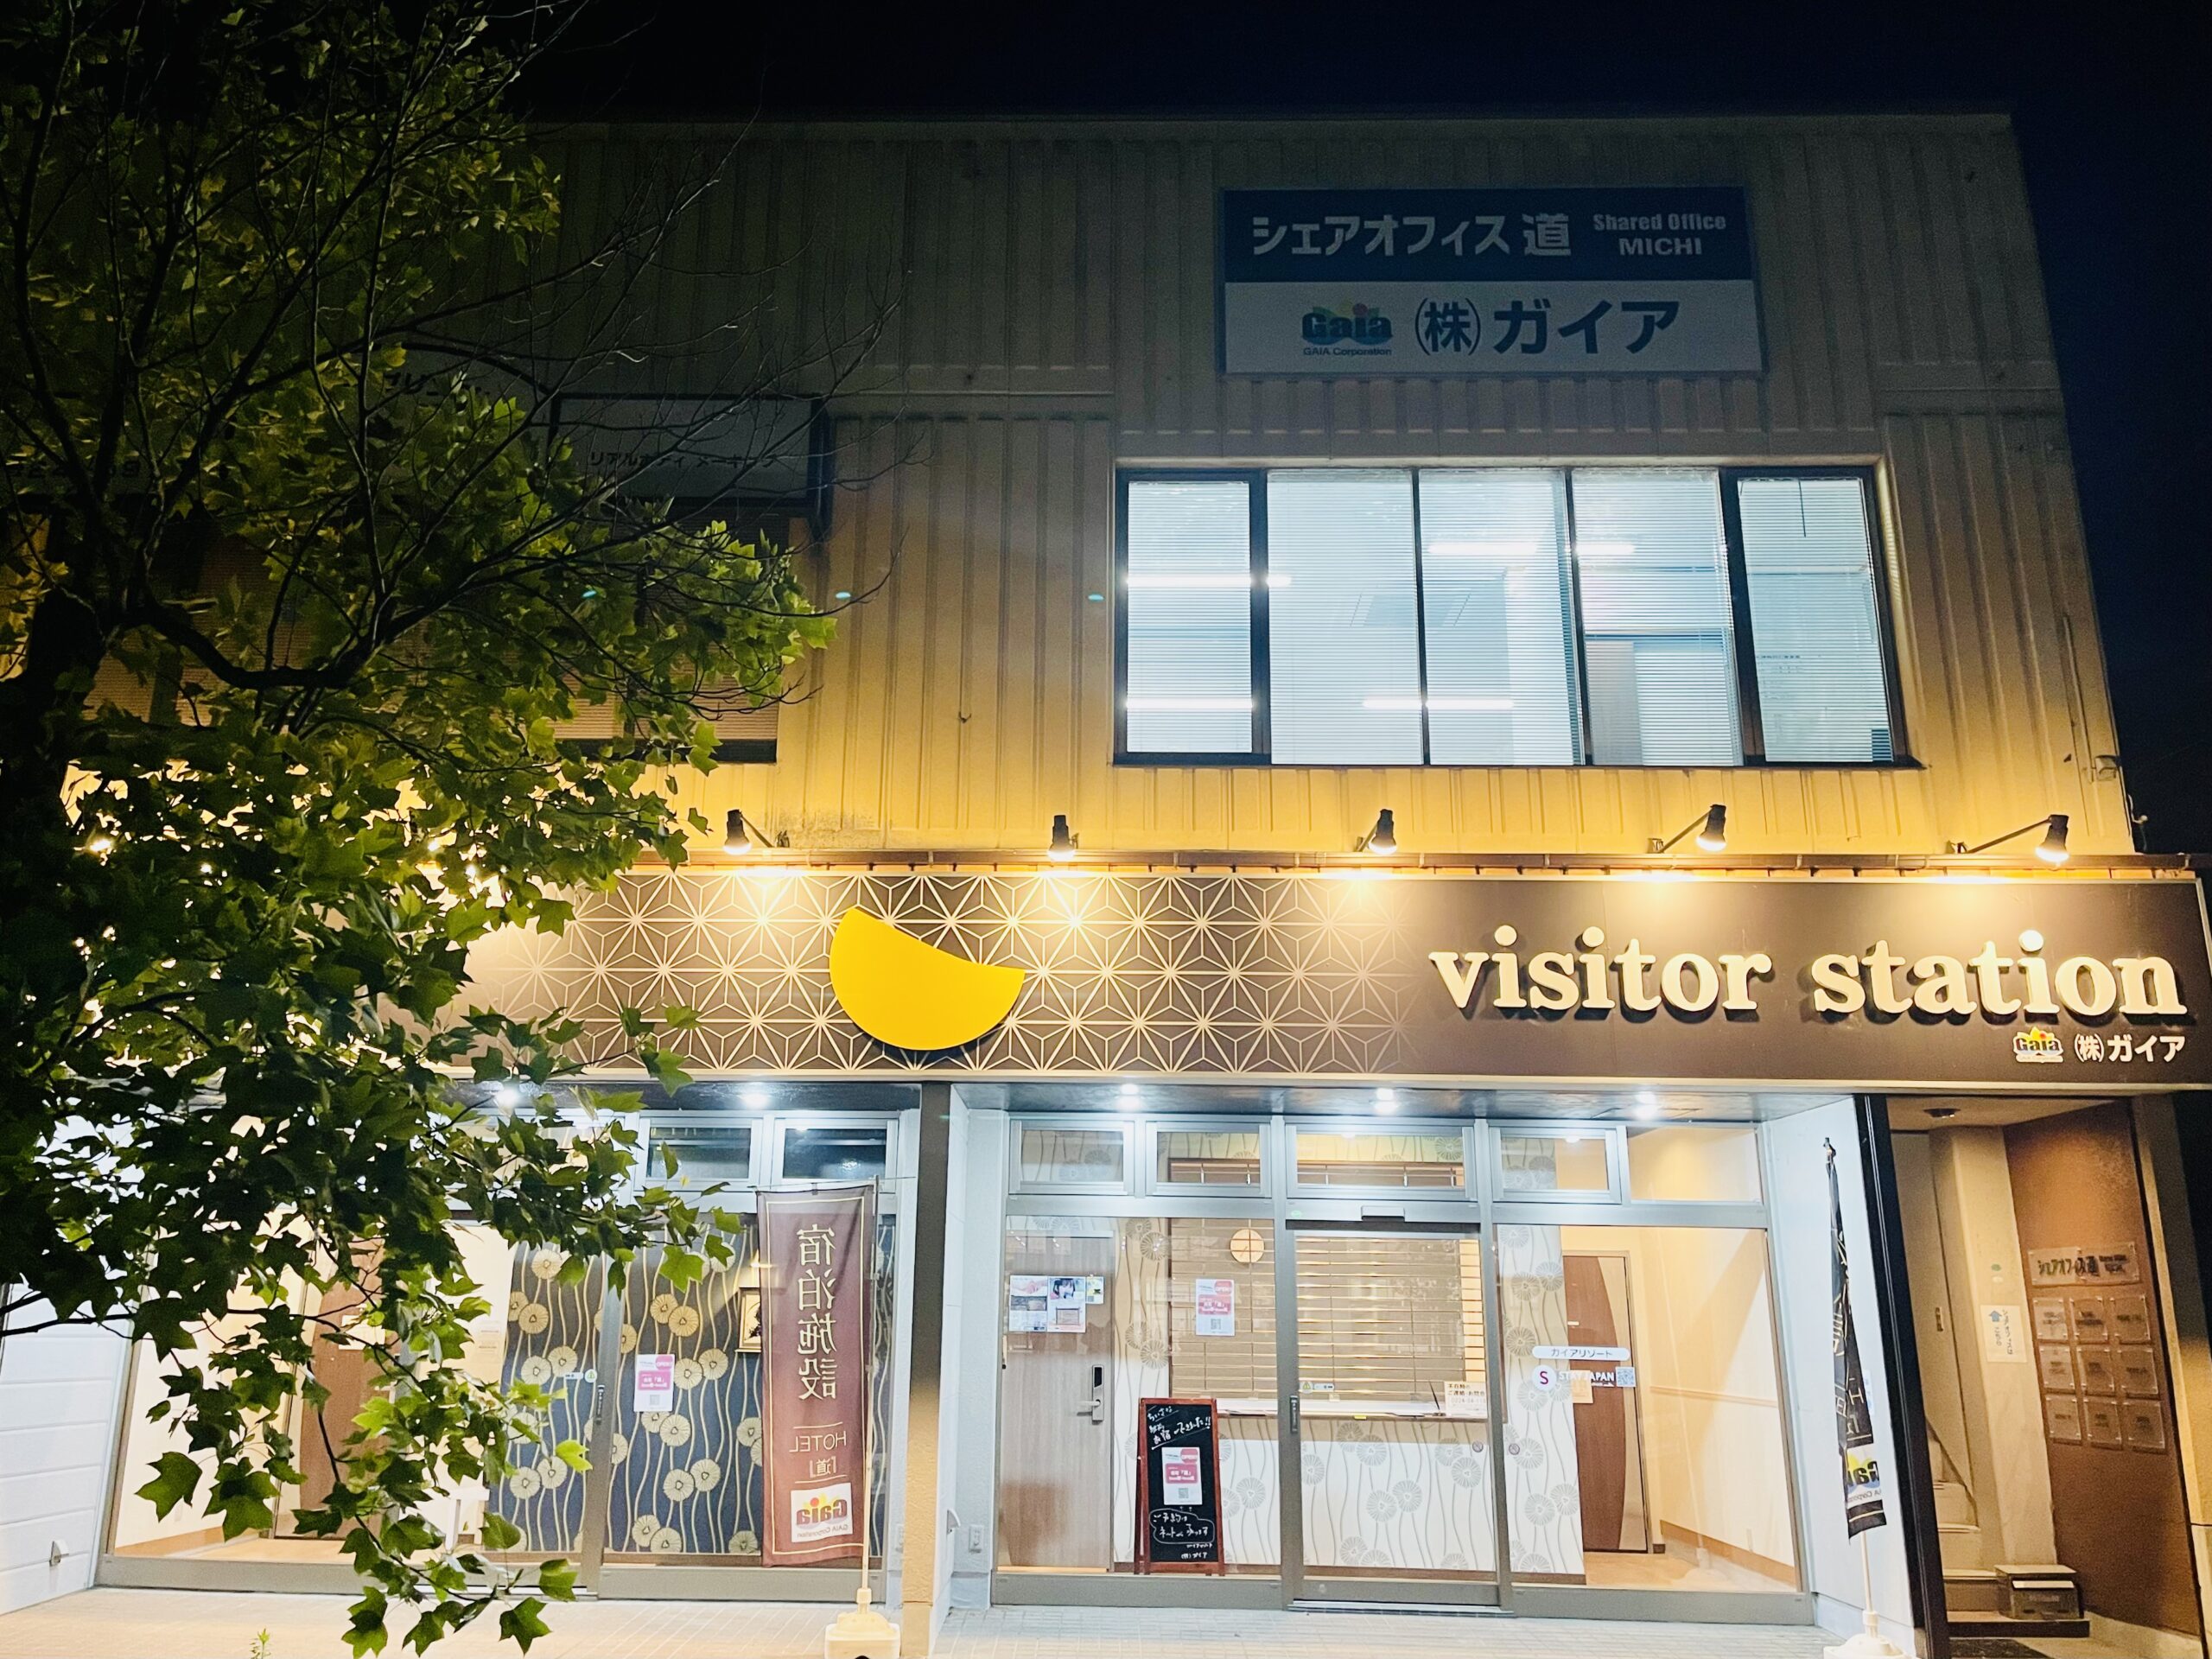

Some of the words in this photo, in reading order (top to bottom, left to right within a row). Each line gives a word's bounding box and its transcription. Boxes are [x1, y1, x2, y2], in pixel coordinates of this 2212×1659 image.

[1592, 213, 1661, 231] Shared
[1667, 213, 1727, 231] Office
[1618, 237, 1702, 256] MICHI
[1302, 303, 1392, 338] Gaia
[1303, 347, 1331, 356] GAIA
[1333, 347, 1393, 356] Corporation
[1429, 925, 1772, 1011] visitor
[1811, 930, 2188, 1017] station
